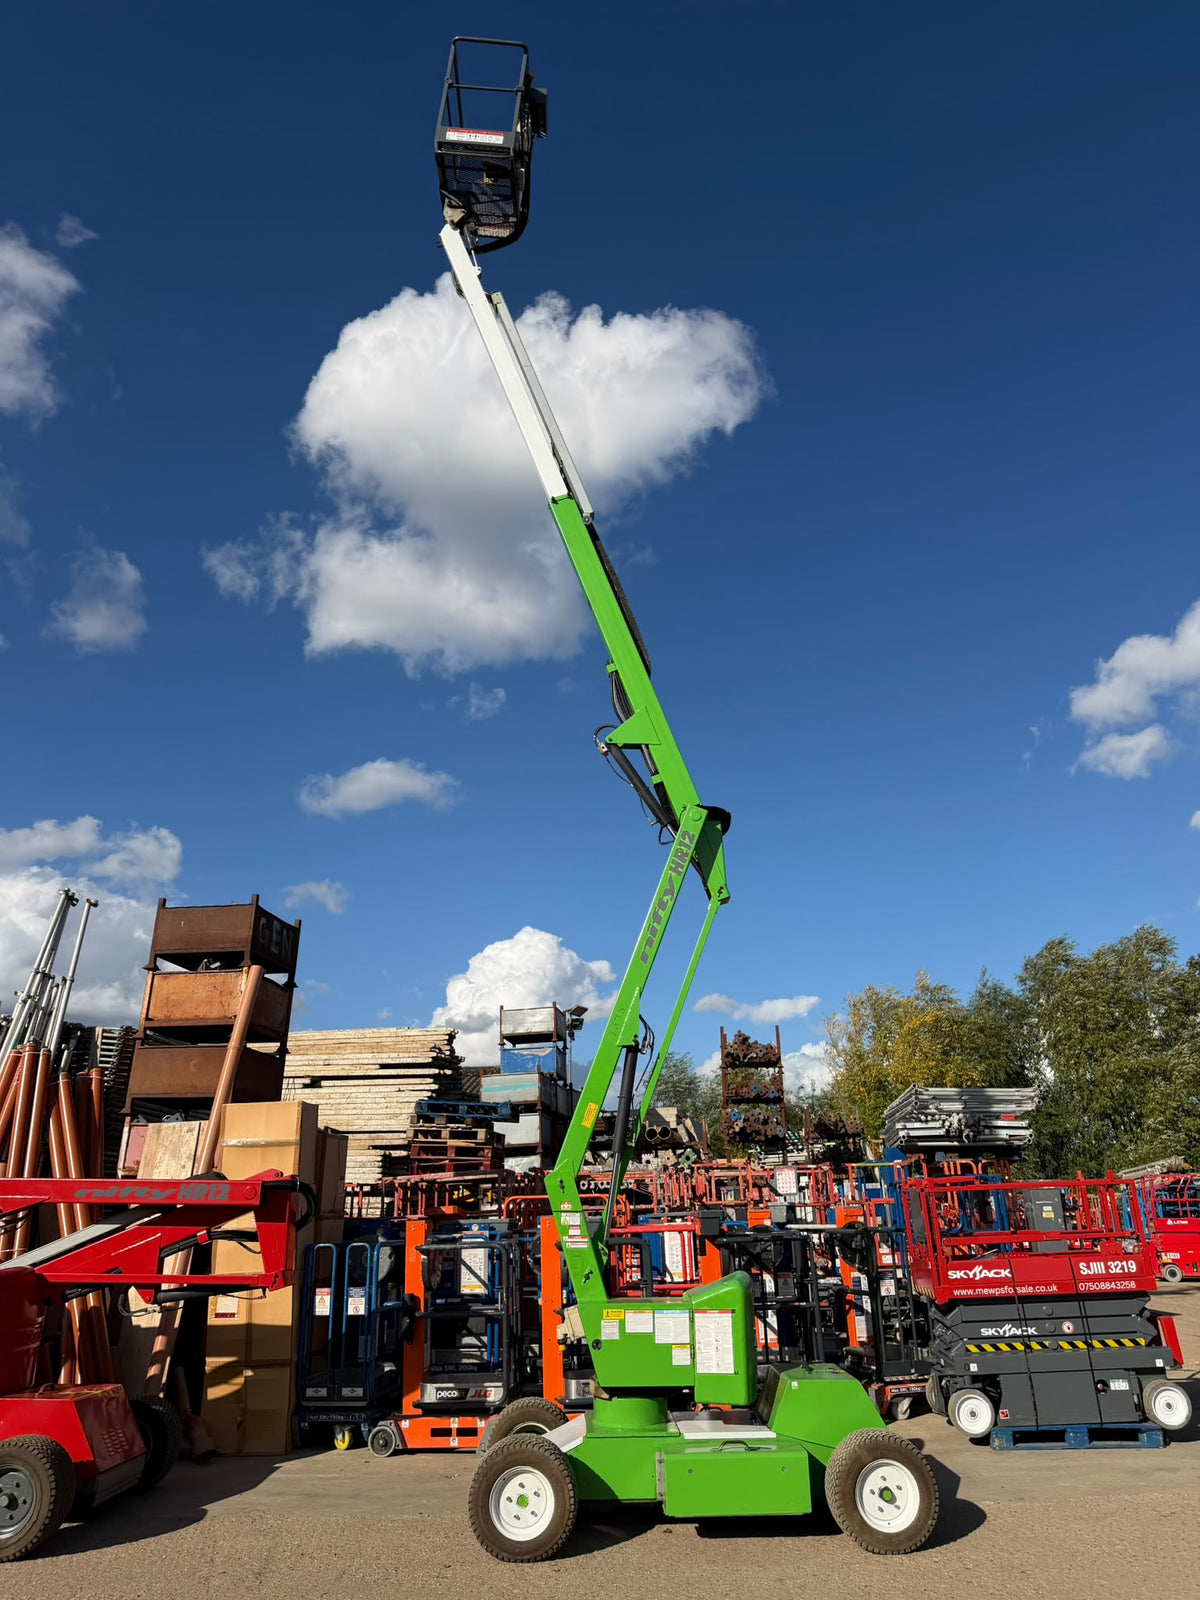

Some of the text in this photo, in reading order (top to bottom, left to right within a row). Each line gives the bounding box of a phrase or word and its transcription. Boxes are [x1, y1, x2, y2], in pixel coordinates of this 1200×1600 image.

[640, 829, 697, 966] nifty HR12
[74, 1183, 231, 1201] nifty HR12
[947, 1264, 1012, 1281] SKYJACK
[1079, 1260, 1137, 1275] SJIII 3219
[953, 1283, 1058, 1296] www.mewpsfosale.co.uk
[1079, 1280, 1136, 1291] 07508843258
[980, 1323, 1038, 1337] SKYJACK
[470, 1389, 493, 1399] JLG
